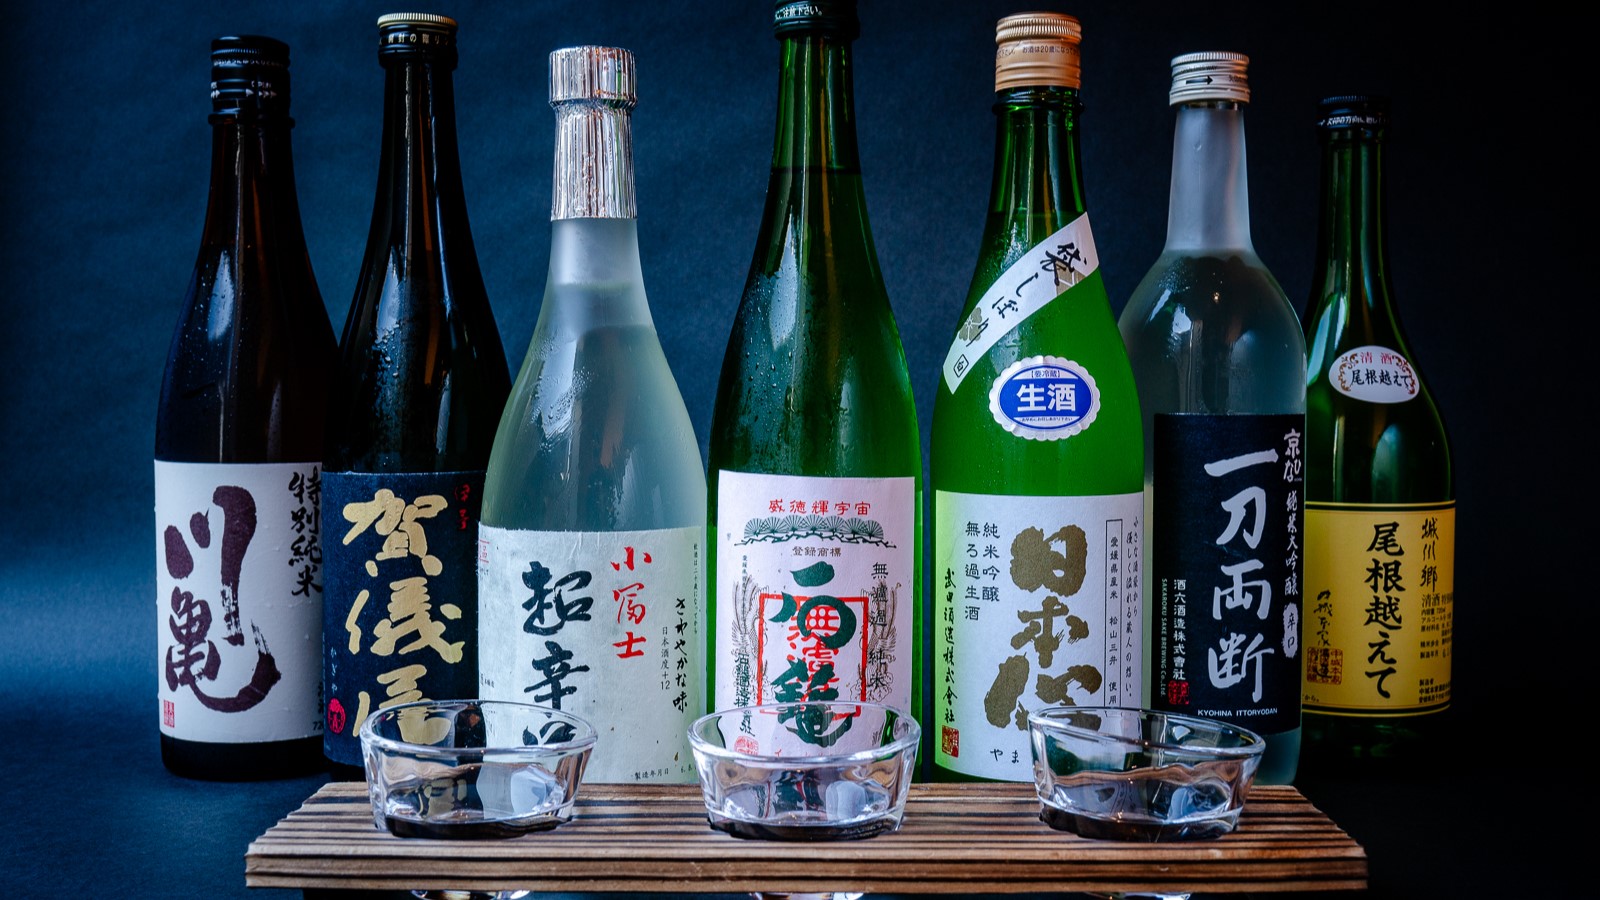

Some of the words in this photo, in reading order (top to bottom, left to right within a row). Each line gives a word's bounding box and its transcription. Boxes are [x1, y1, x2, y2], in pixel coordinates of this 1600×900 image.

[1016, 384, 1077, 412] 生酒
[1350, 363, 1411, 390] 尾根越えて
[288, 466, 323, 598] 特別純米
[964, 520, 981, 622] 無ろ過生酒
[982, 522, 1001, 602] 純米吟醸
[1203, 448, 1279, 703] 一刀両断
[1285, 490, 1299, 597] 純米大吟醸
[163, 485, 282, 713] 川亀
[1108, 615, 1119, 666] 松山三井
[1172, 579, 1187, 681] 酒六酒造株式會社
[1287, 612, 1296, 649] 辛口
[1363, 521, 1407, 700] 尾根越えて
[672, 597, 689, 714] さわやかな味
[1108, 680, 1118, 705] 使用
[990, 748, 1020, 764] やま
[1197, 709, 1233, 717] KYOHINA
[1236, 707, 1278, 717] ITTORYODAN
